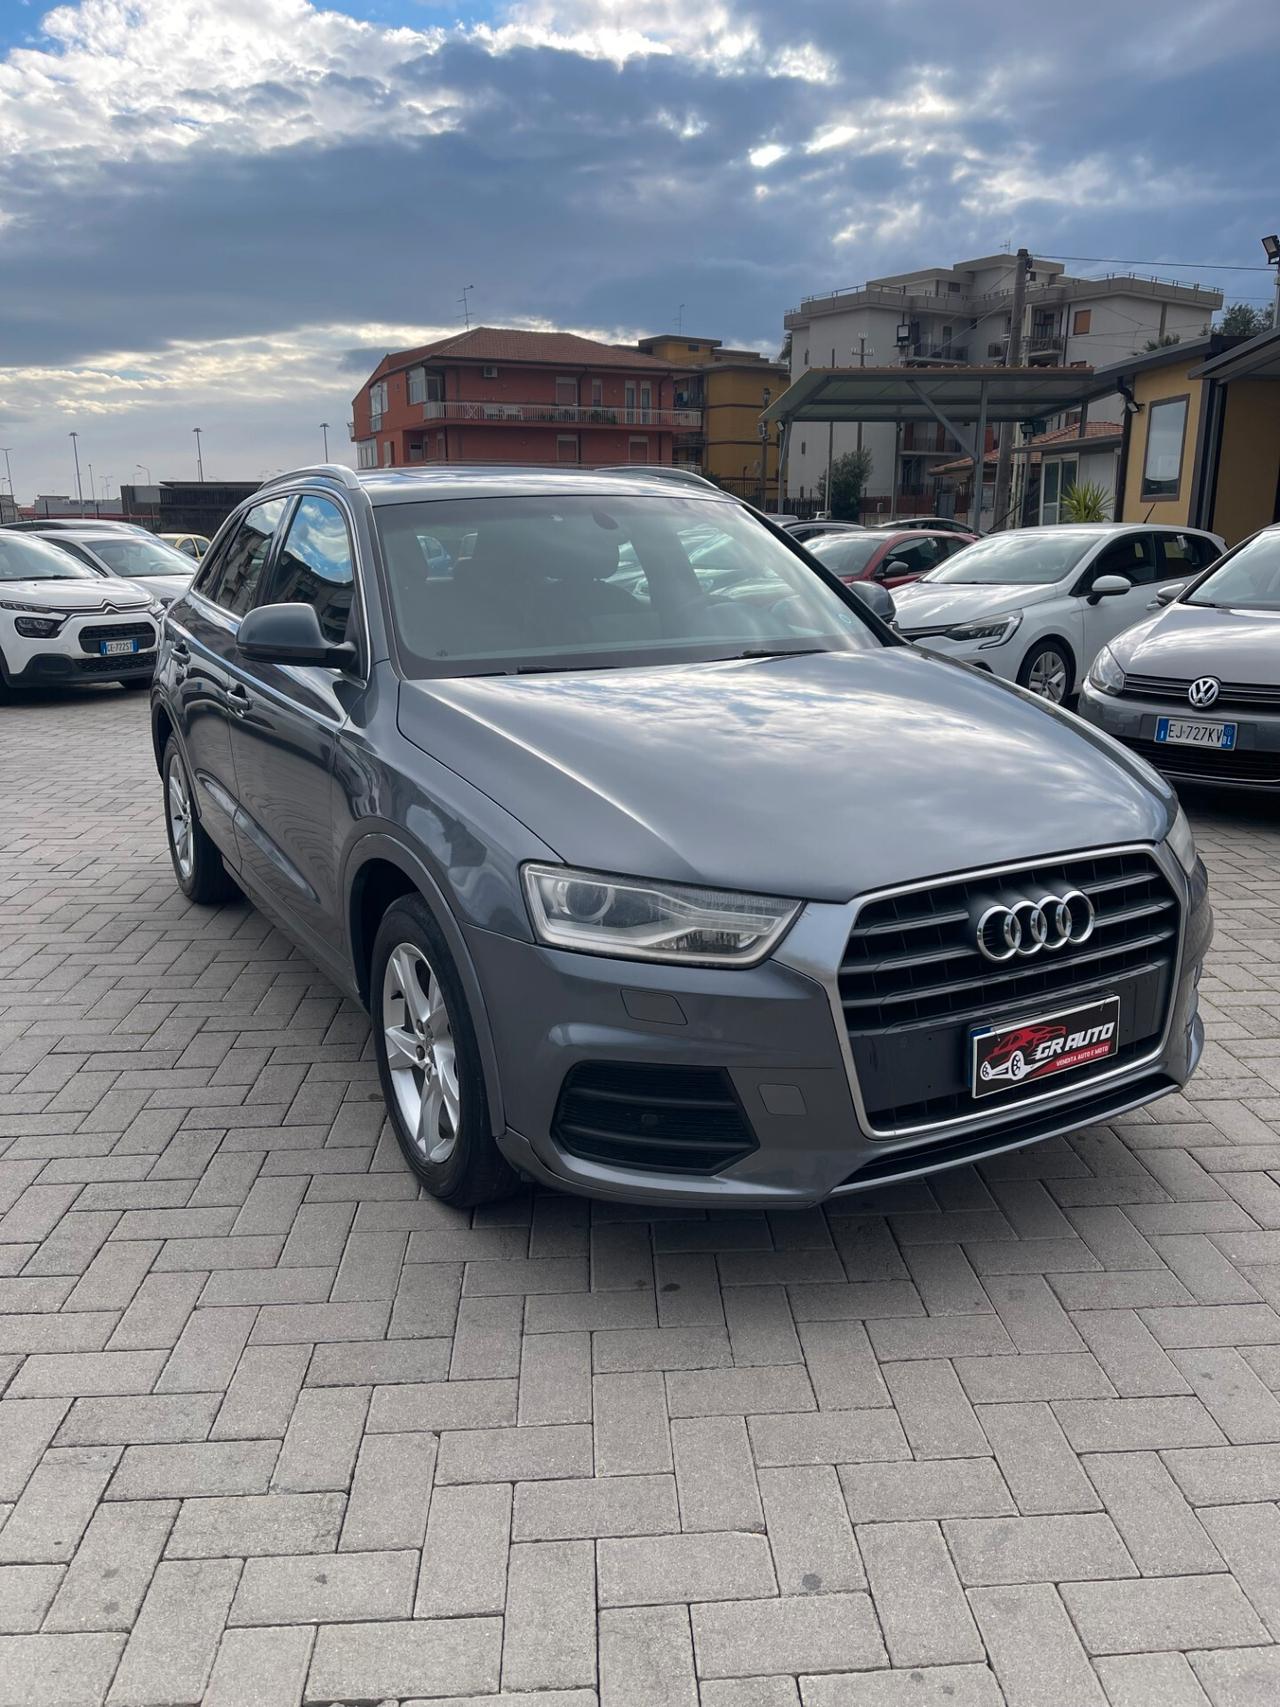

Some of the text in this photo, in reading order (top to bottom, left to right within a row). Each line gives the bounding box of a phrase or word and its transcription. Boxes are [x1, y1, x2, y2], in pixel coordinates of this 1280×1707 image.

[1034, 1022, 1115, 1060] GR AUTO
[1056, 1056, 1077, 1067] VENDITA
[1077, 1051, 1091, 1059] AUTO
[1094, 1045, 1109, 1054] MOTO
